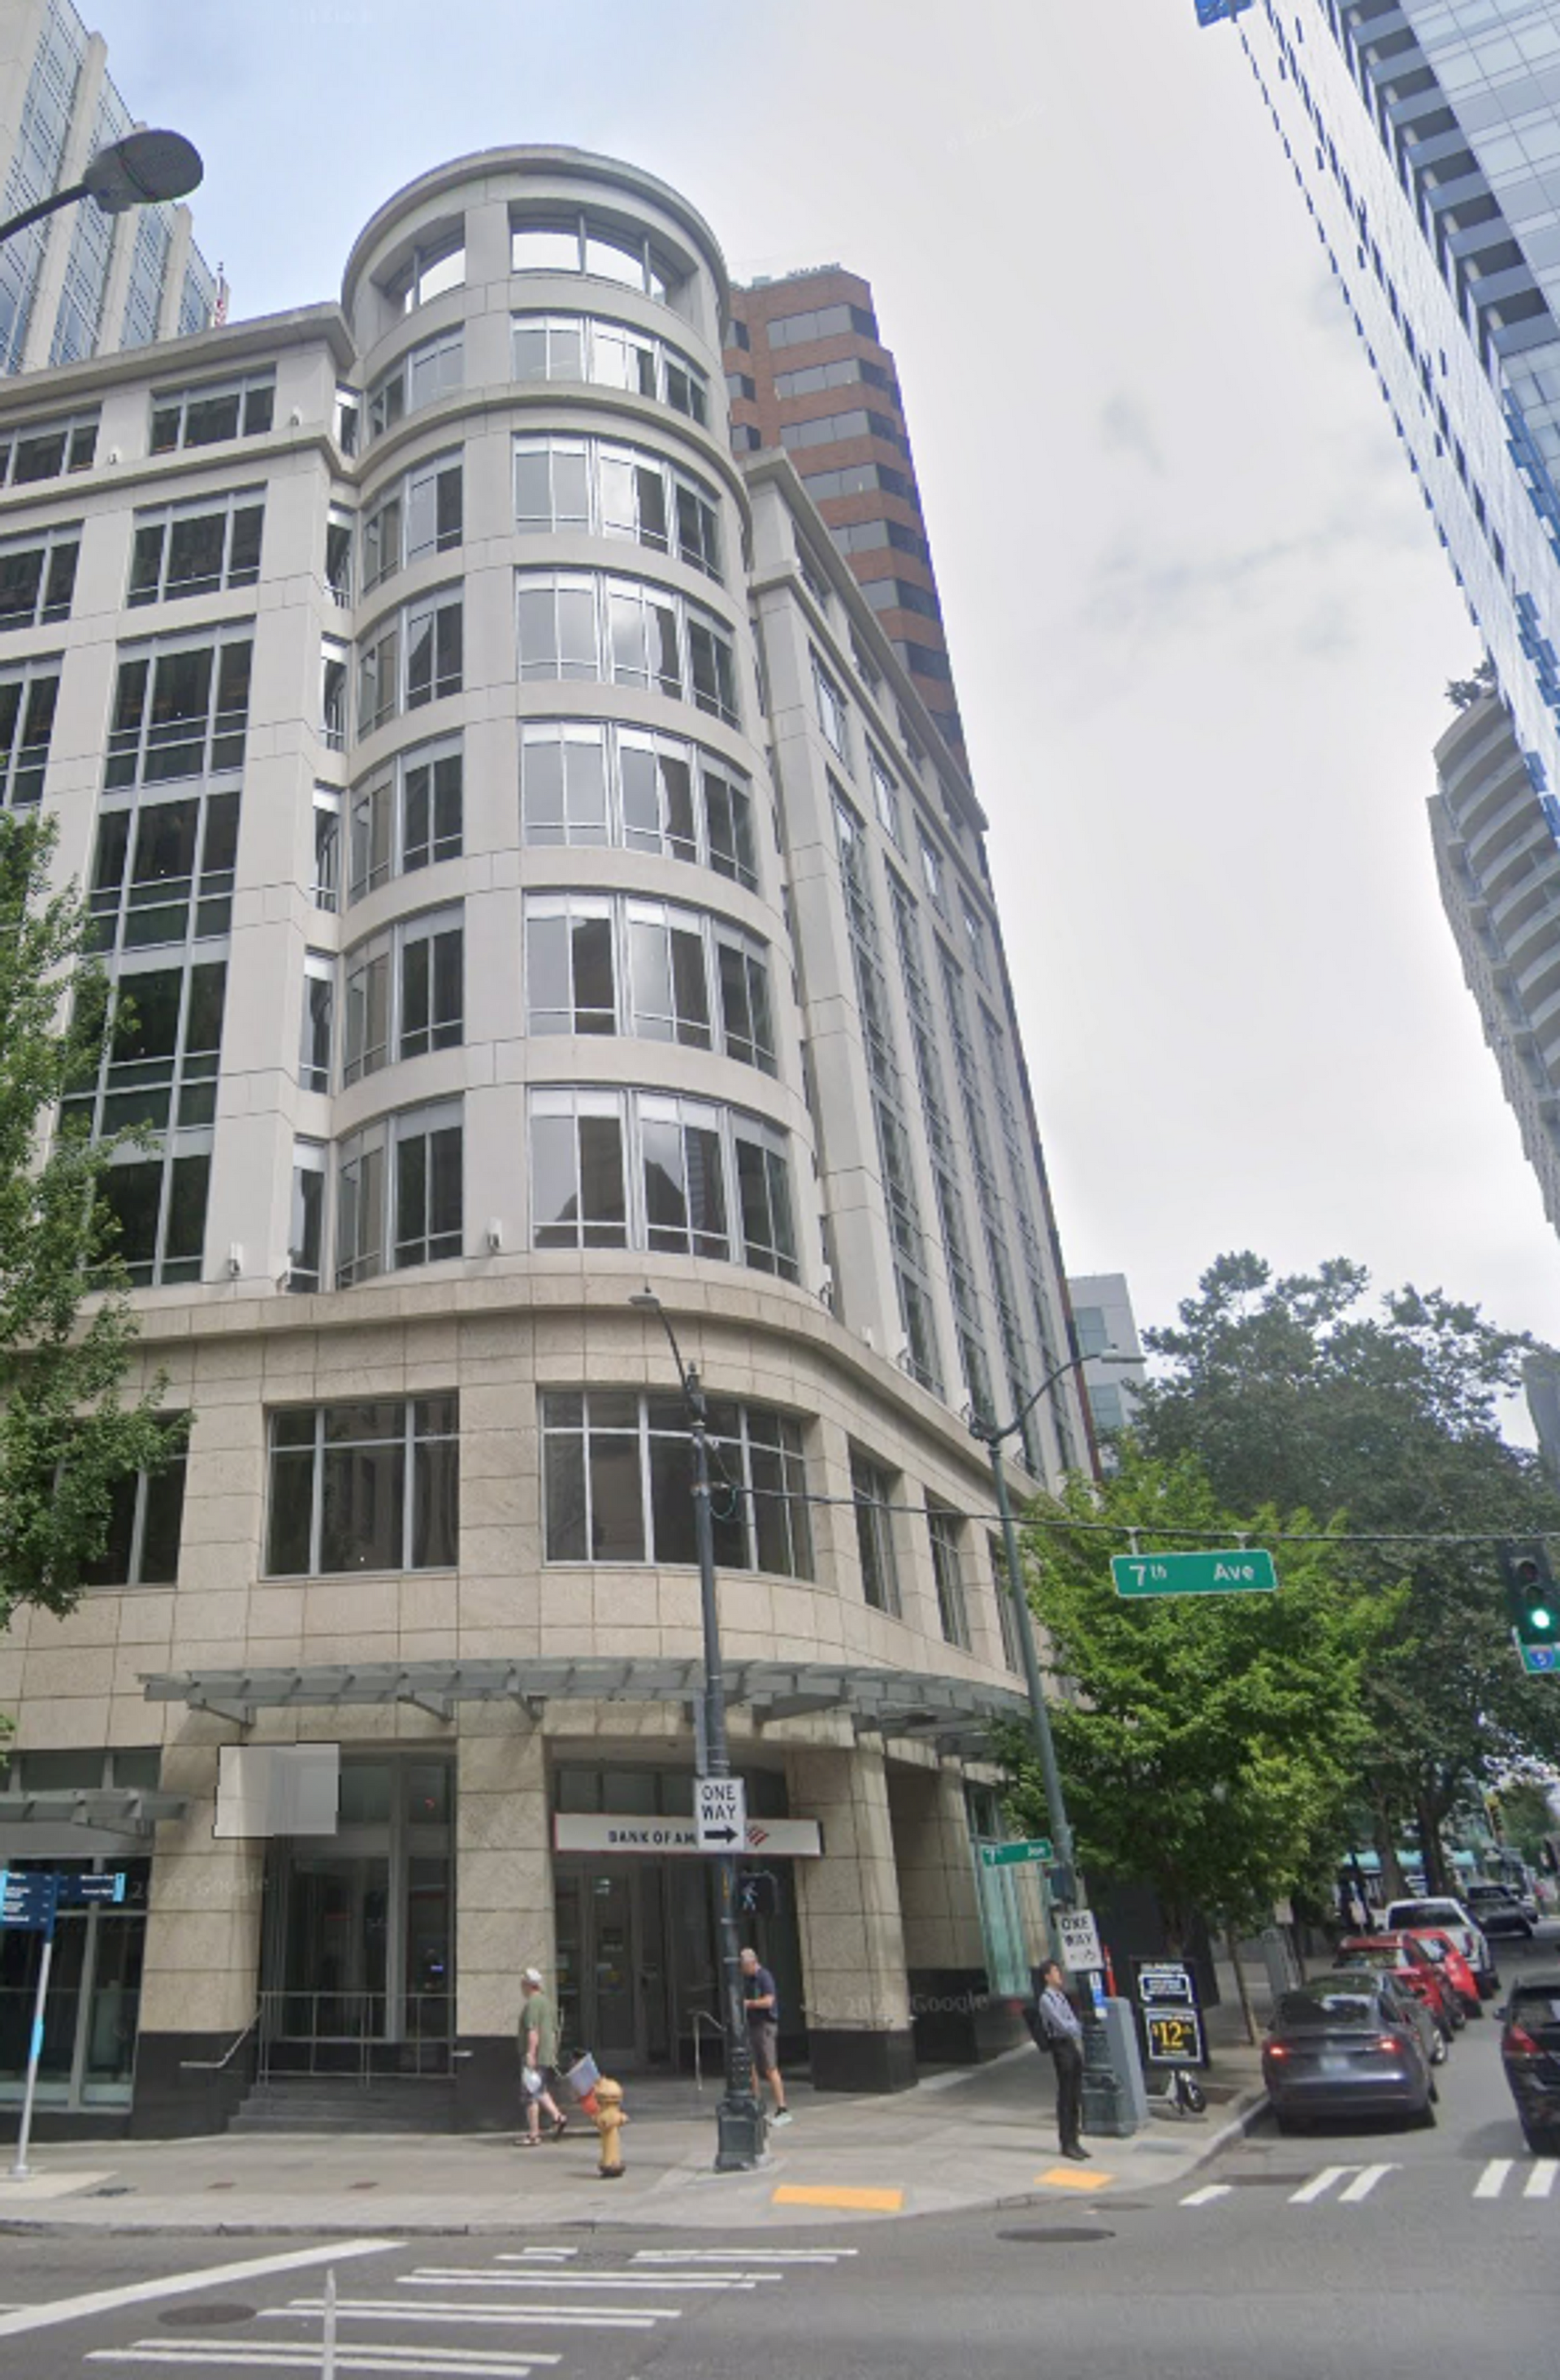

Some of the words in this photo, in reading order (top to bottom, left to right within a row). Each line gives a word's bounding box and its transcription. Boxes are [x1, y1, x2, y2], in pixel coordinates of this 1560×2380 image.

[1129, 1563, 1168, 1587] 7th
[1214, 1562, 1255, 1581] Ave
[701, 1784, 736, 1801] ONE
[701, 1804, 736, 1820] WAY
[609, 1830, 648, 1844] BANK
[652, 1830, 670, 1845] OF
[1061, 1916, 1090, 1930] ONE
[1064, 1933, 1094, 1946] WAY
